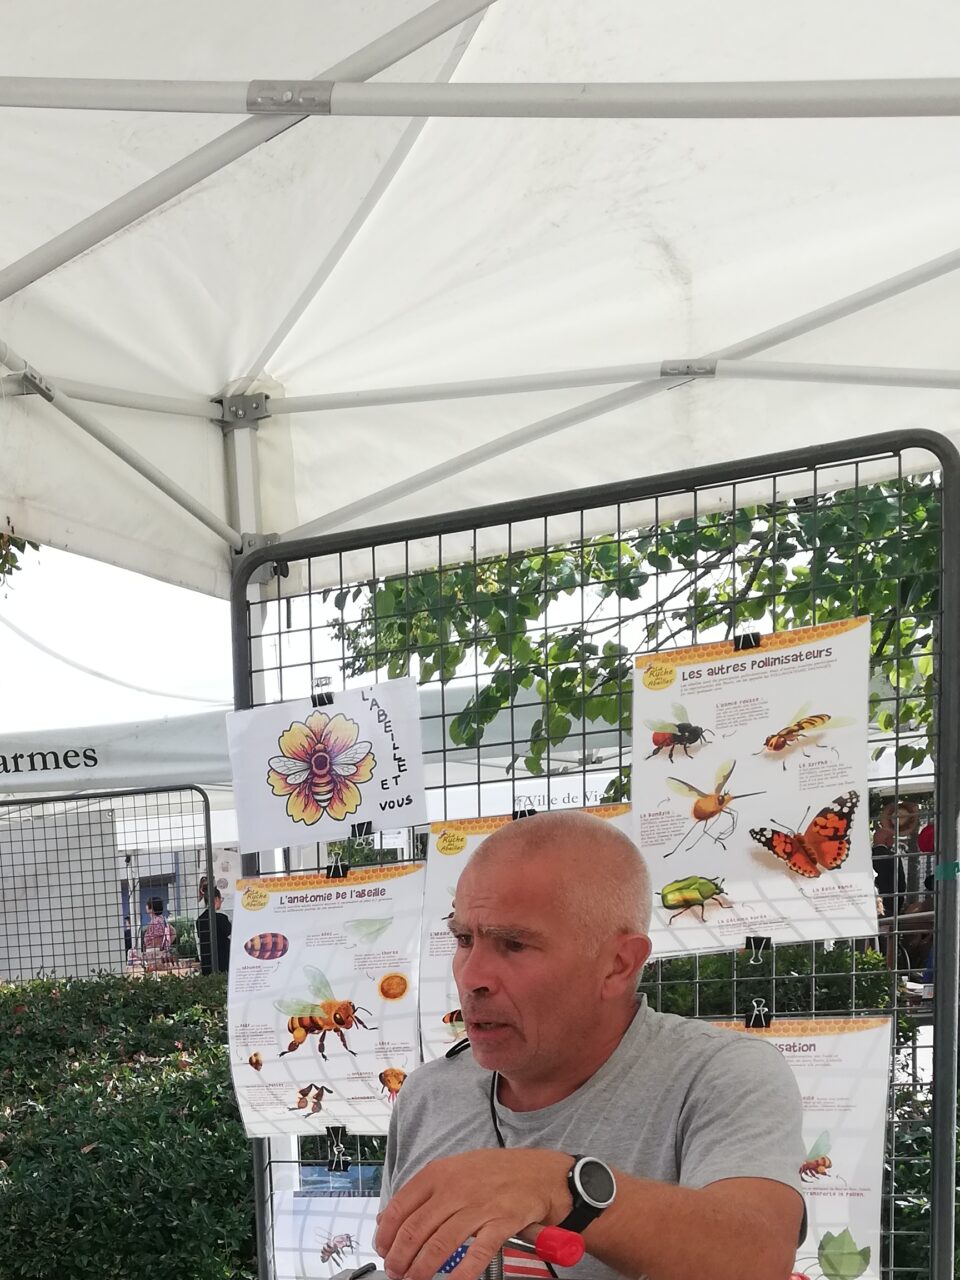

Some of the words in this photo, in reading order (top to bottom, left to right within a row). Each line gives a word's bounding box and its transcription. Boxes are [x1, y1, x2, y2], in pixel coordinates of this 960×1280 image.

[682, 668, 702, 682] Les
[706, 661, 747, 677] autres
[380, 774, 401, 791] ET
[379, 794, 414, 812] VOUS
[525, 793, 558, 808] Vile
[562, 792, 579, 804] de
[279, 891, 333, 906] L'anatomie
[775, 1042, 816, 1053] sation
